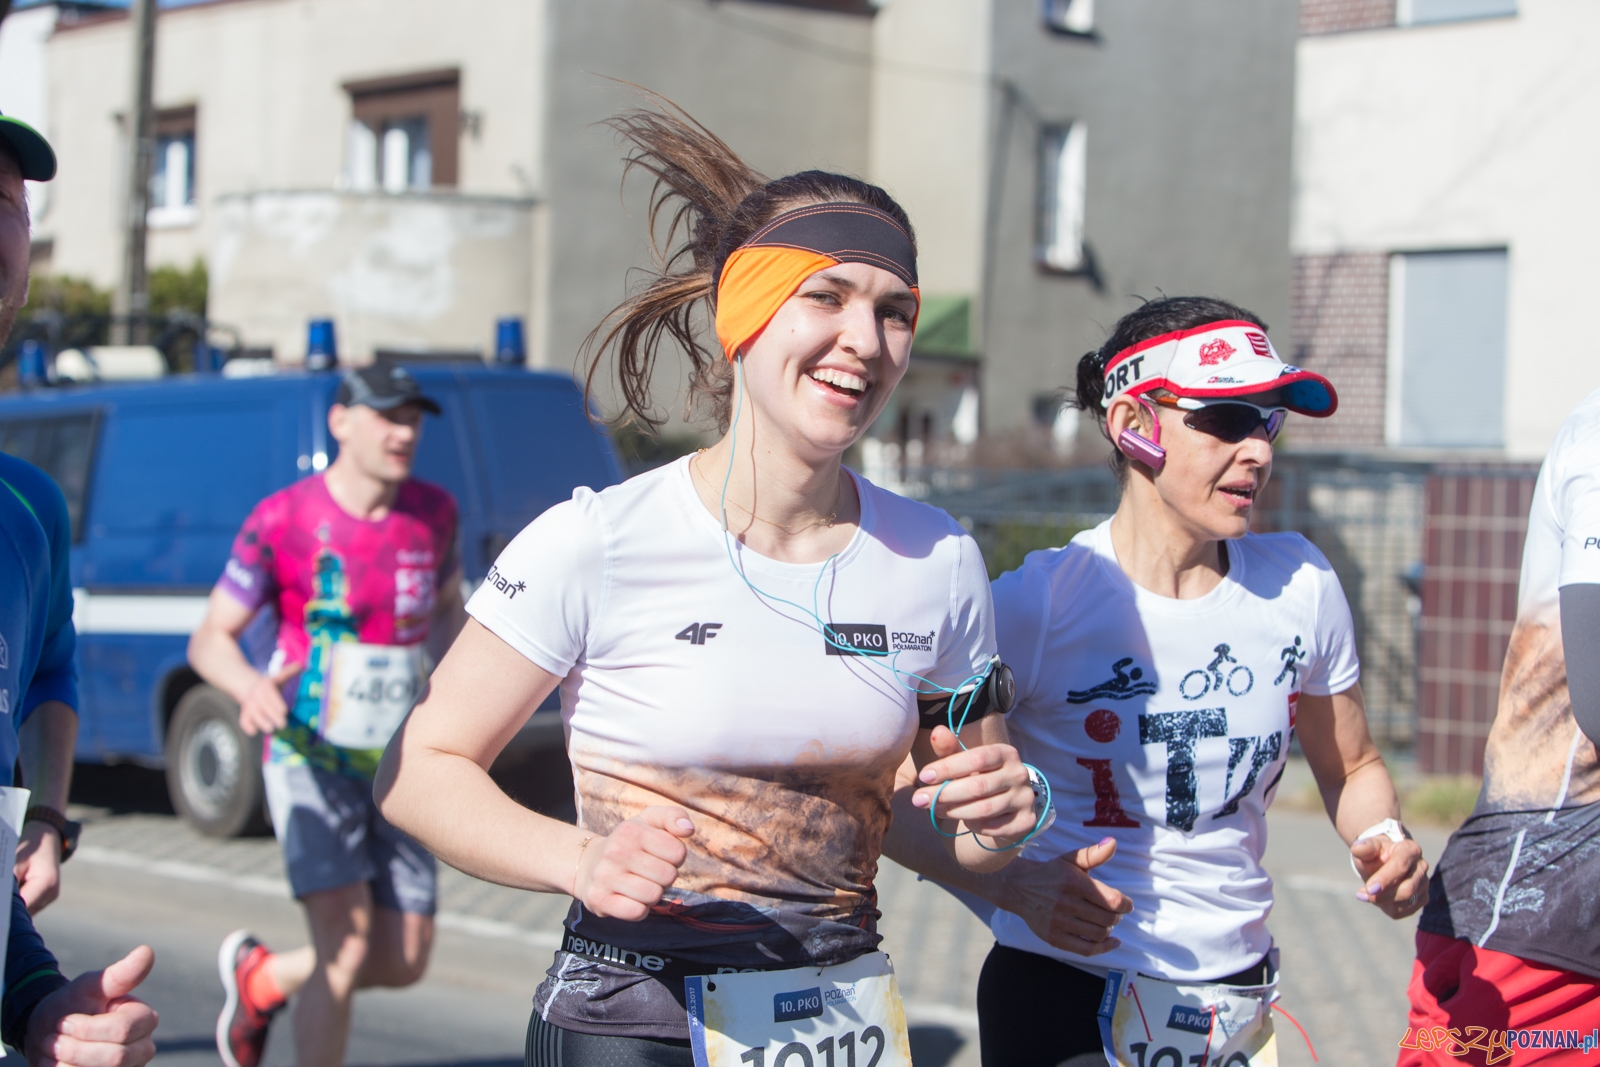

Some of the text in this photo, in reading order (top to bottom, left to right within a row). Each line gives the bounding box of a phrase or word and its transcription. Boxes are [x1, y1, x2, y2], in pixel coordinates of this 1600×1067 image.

[1105, 355, 1145, 399] ORT
[1584, 537, 1600, 550] P
[675, 622, 723, 646] 4F
[853, 632, 883, 648] PKO
[688, 987, 698, 1026] 26.03.2017
[779, 996, 819, 1014] 10. PKO
[1174, 1012, 1211, 1028] 10. PKO
